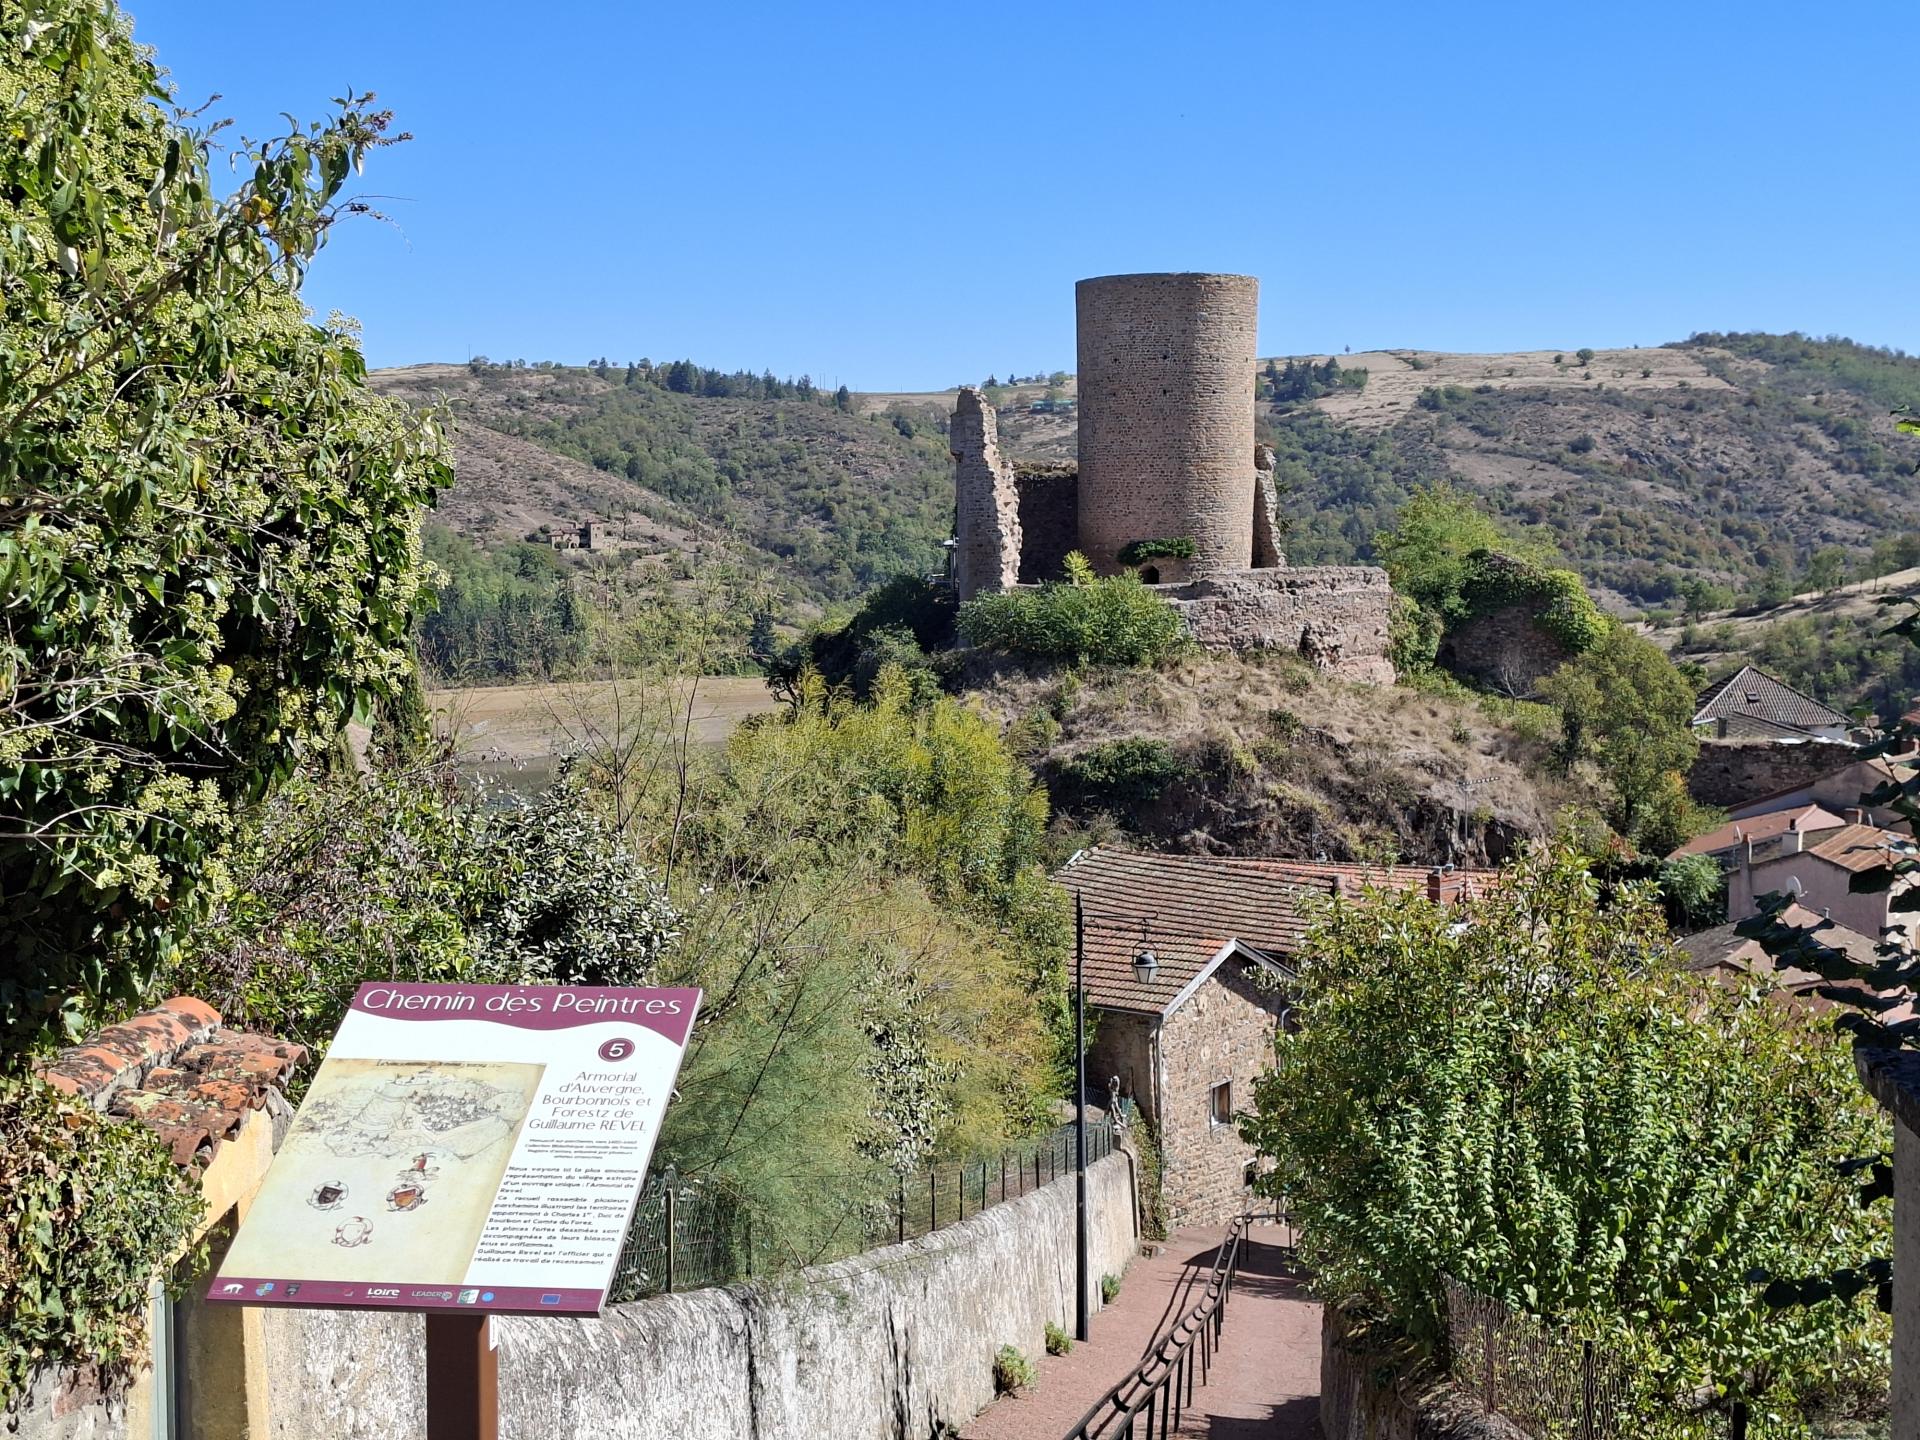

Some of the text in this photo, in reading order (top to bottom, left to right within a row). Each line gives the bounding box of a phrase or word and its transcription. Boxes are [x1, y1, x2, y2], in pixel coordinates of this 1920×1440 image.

[363, 989, 682, 1014] Chemin des Peintres
[608, 1043, 624, 1057] 5
[576, 1072, 637, 1082] Armorial
[635, 1098, 651, 1107] et
[551, 1107, 634, 1118] Forestz de
[529, 1119, 647, 1131] Guillaume REVEL
[368, 1287, 400, 1296] Loire
